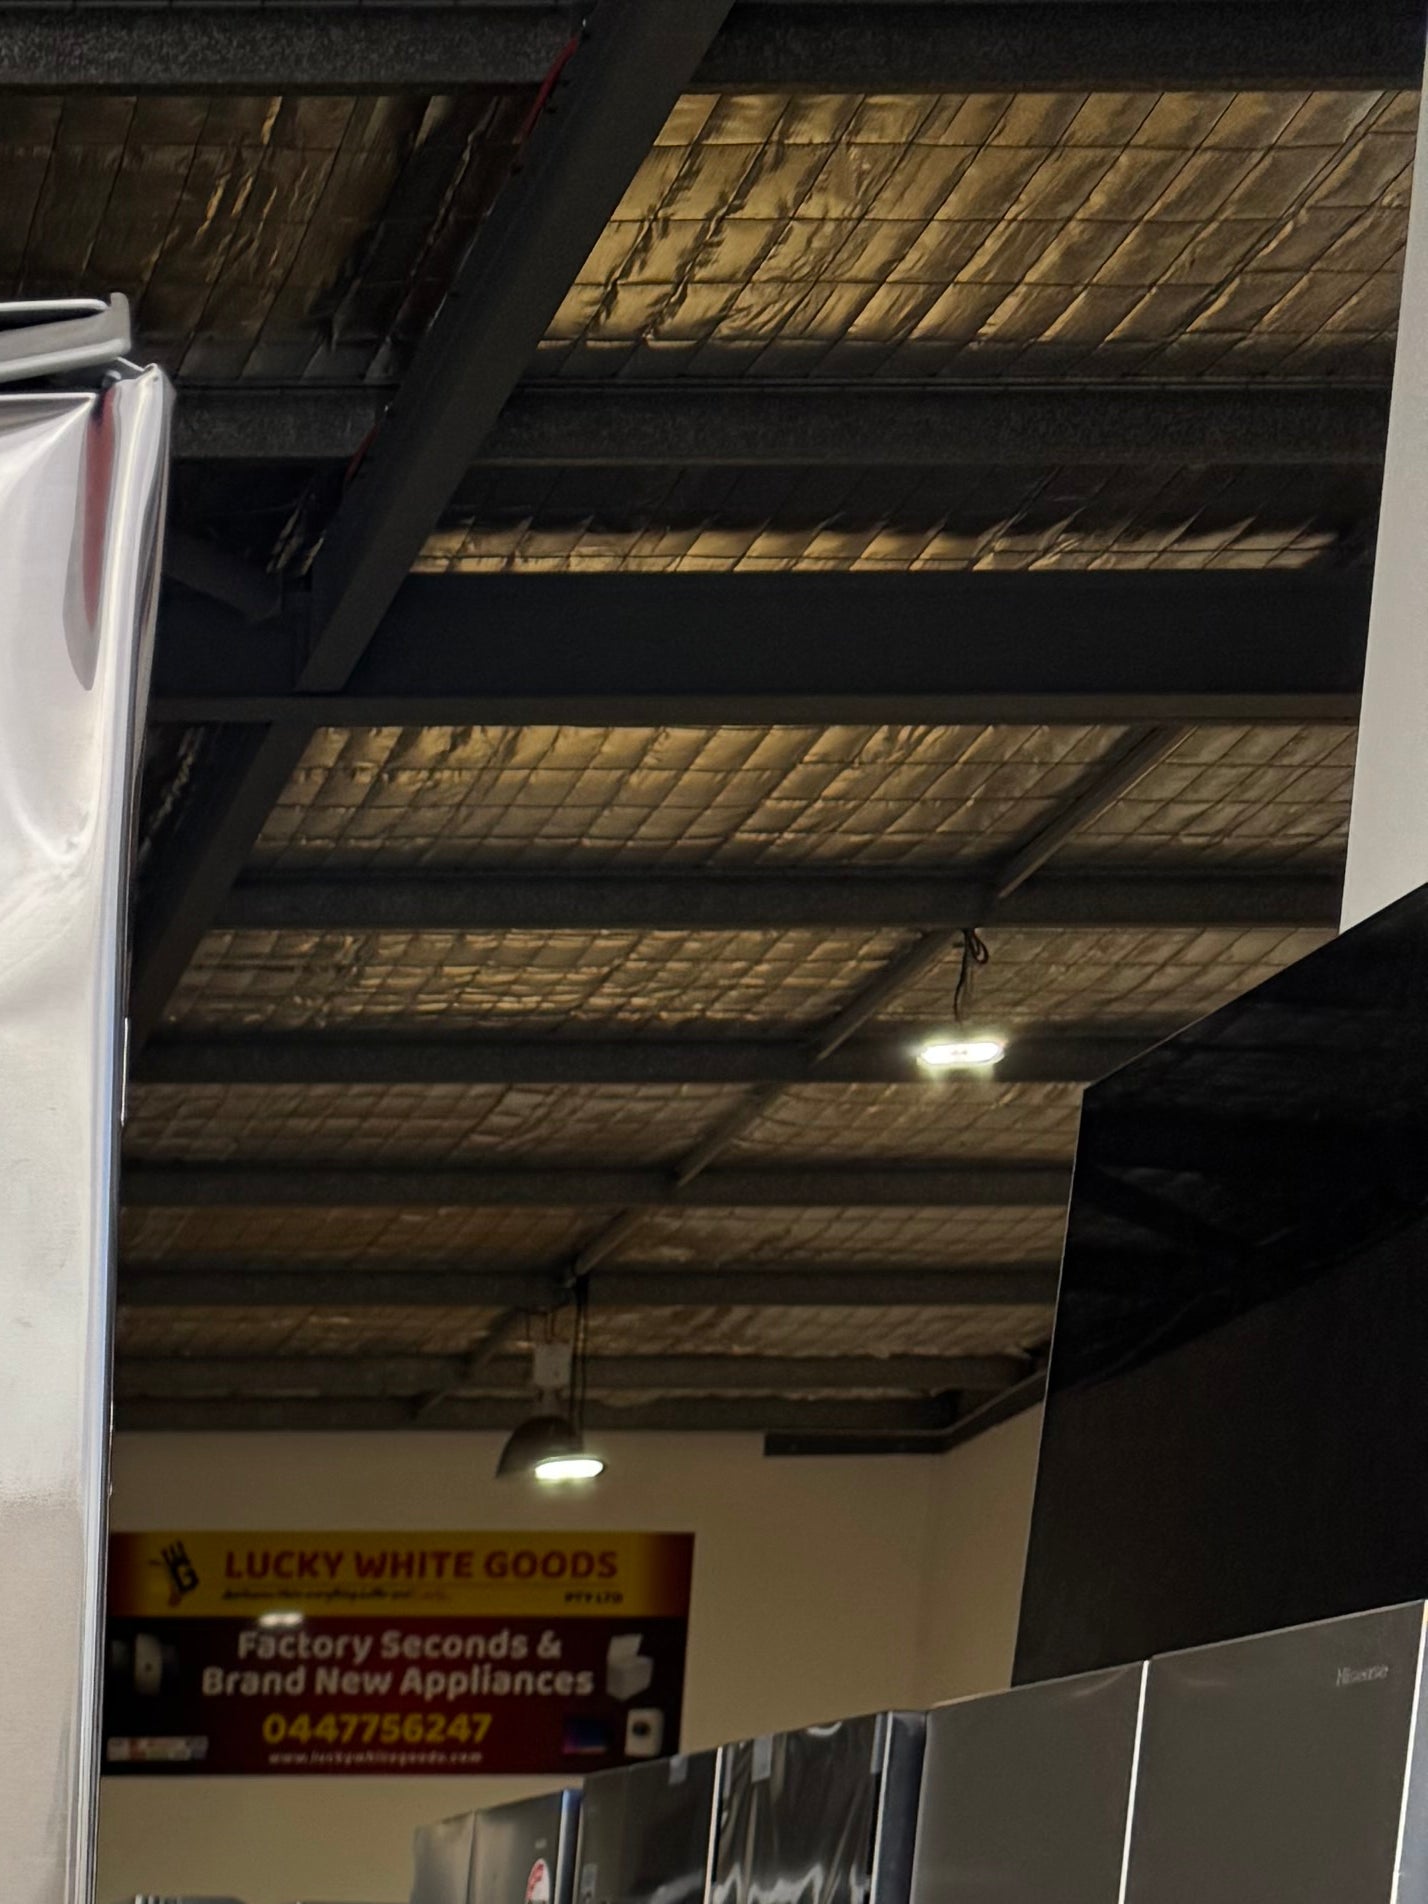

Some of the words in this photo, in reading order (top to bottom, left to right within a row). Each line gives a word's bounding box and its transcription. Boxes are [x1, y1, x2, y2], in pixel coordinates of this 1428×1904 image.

[224, 1551, 344, 1580] LUCKY
[355, 1551, 473, 1580] WHITE
[484, 1551, 618, 1580] GOODS
[238, 1630, 372, 1663] Factory
[380, 1630, 530, 1659] Seconds
[536, 1630, 562, 1659] &
[201, 1666, 306, 1695] Brand
[315, 1667, 390, 1695] New
[400, 1663, 594, 1700] Appliances
[263, 1712, 492, 1744] 0447756247
